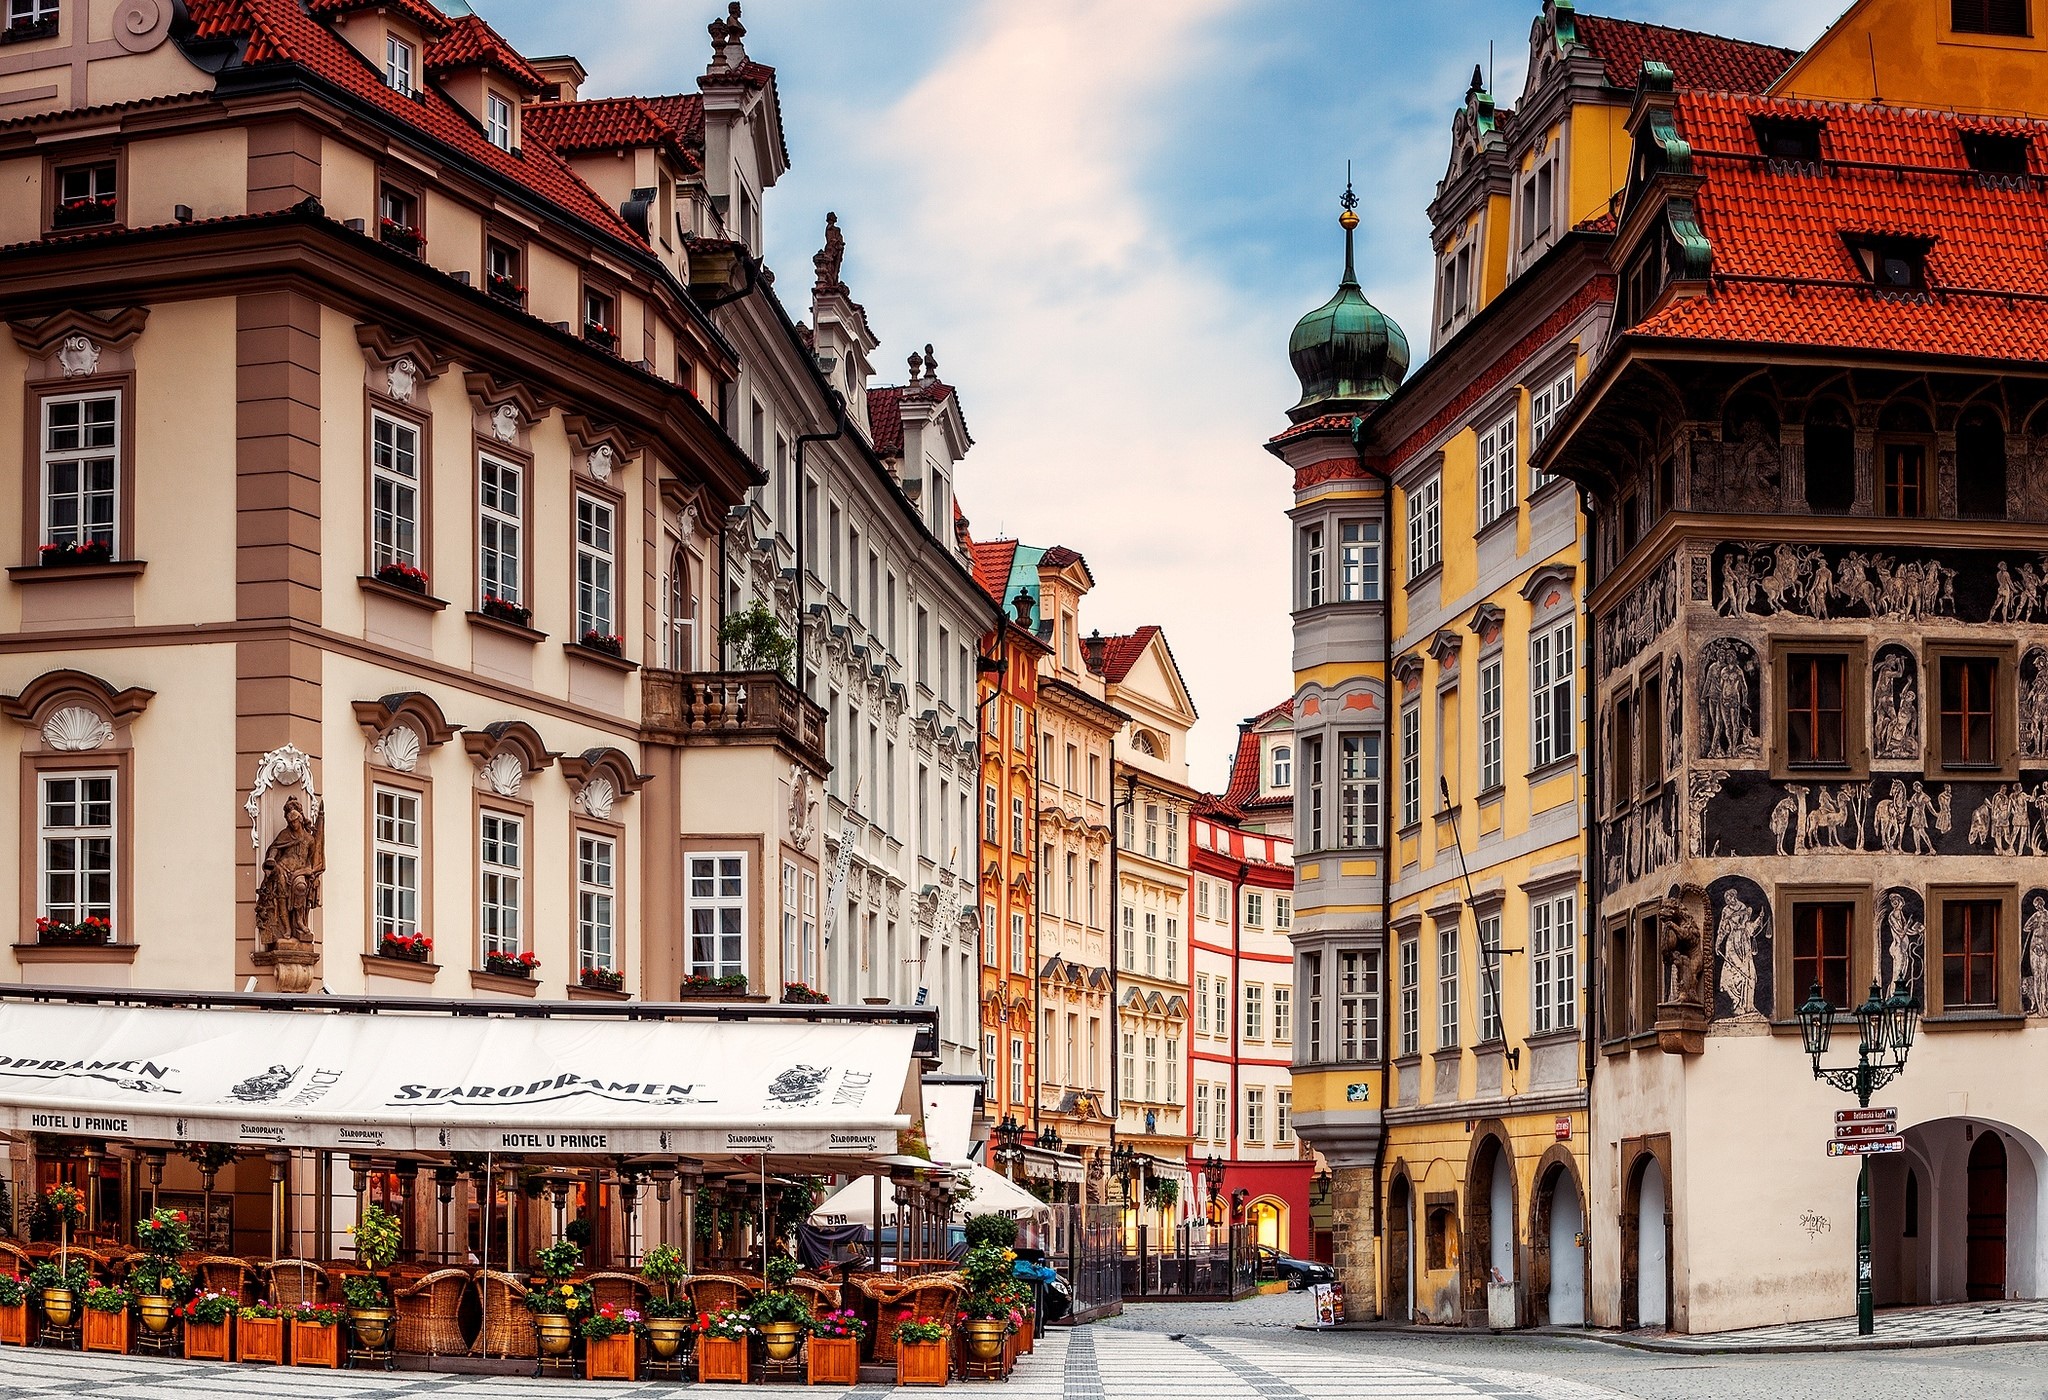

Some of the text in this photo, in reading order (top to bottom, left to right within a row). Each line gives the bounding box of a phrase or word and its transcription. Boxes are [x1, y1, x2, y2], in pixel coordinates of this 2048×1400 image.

[393, 1073, 694, 1099] STAROPRAMEN
[32, 1114, 128, 1132] HOTEL U PRINCE
[240, 1124, 284, 1135] STAROPRAMEN
[339, 1128, 384, 1139] STAROPRAMEN
[502, 1133, 607, 1148] HOTEL U PRINCE
[727, 1133, 774, 1144] STAROPRAMEN
[830, 1133, 876, 1144] STAROPRAMEN
[826, 1213, 848, 1225] BAR
[998, 1209, 1018, 1220] BAR
